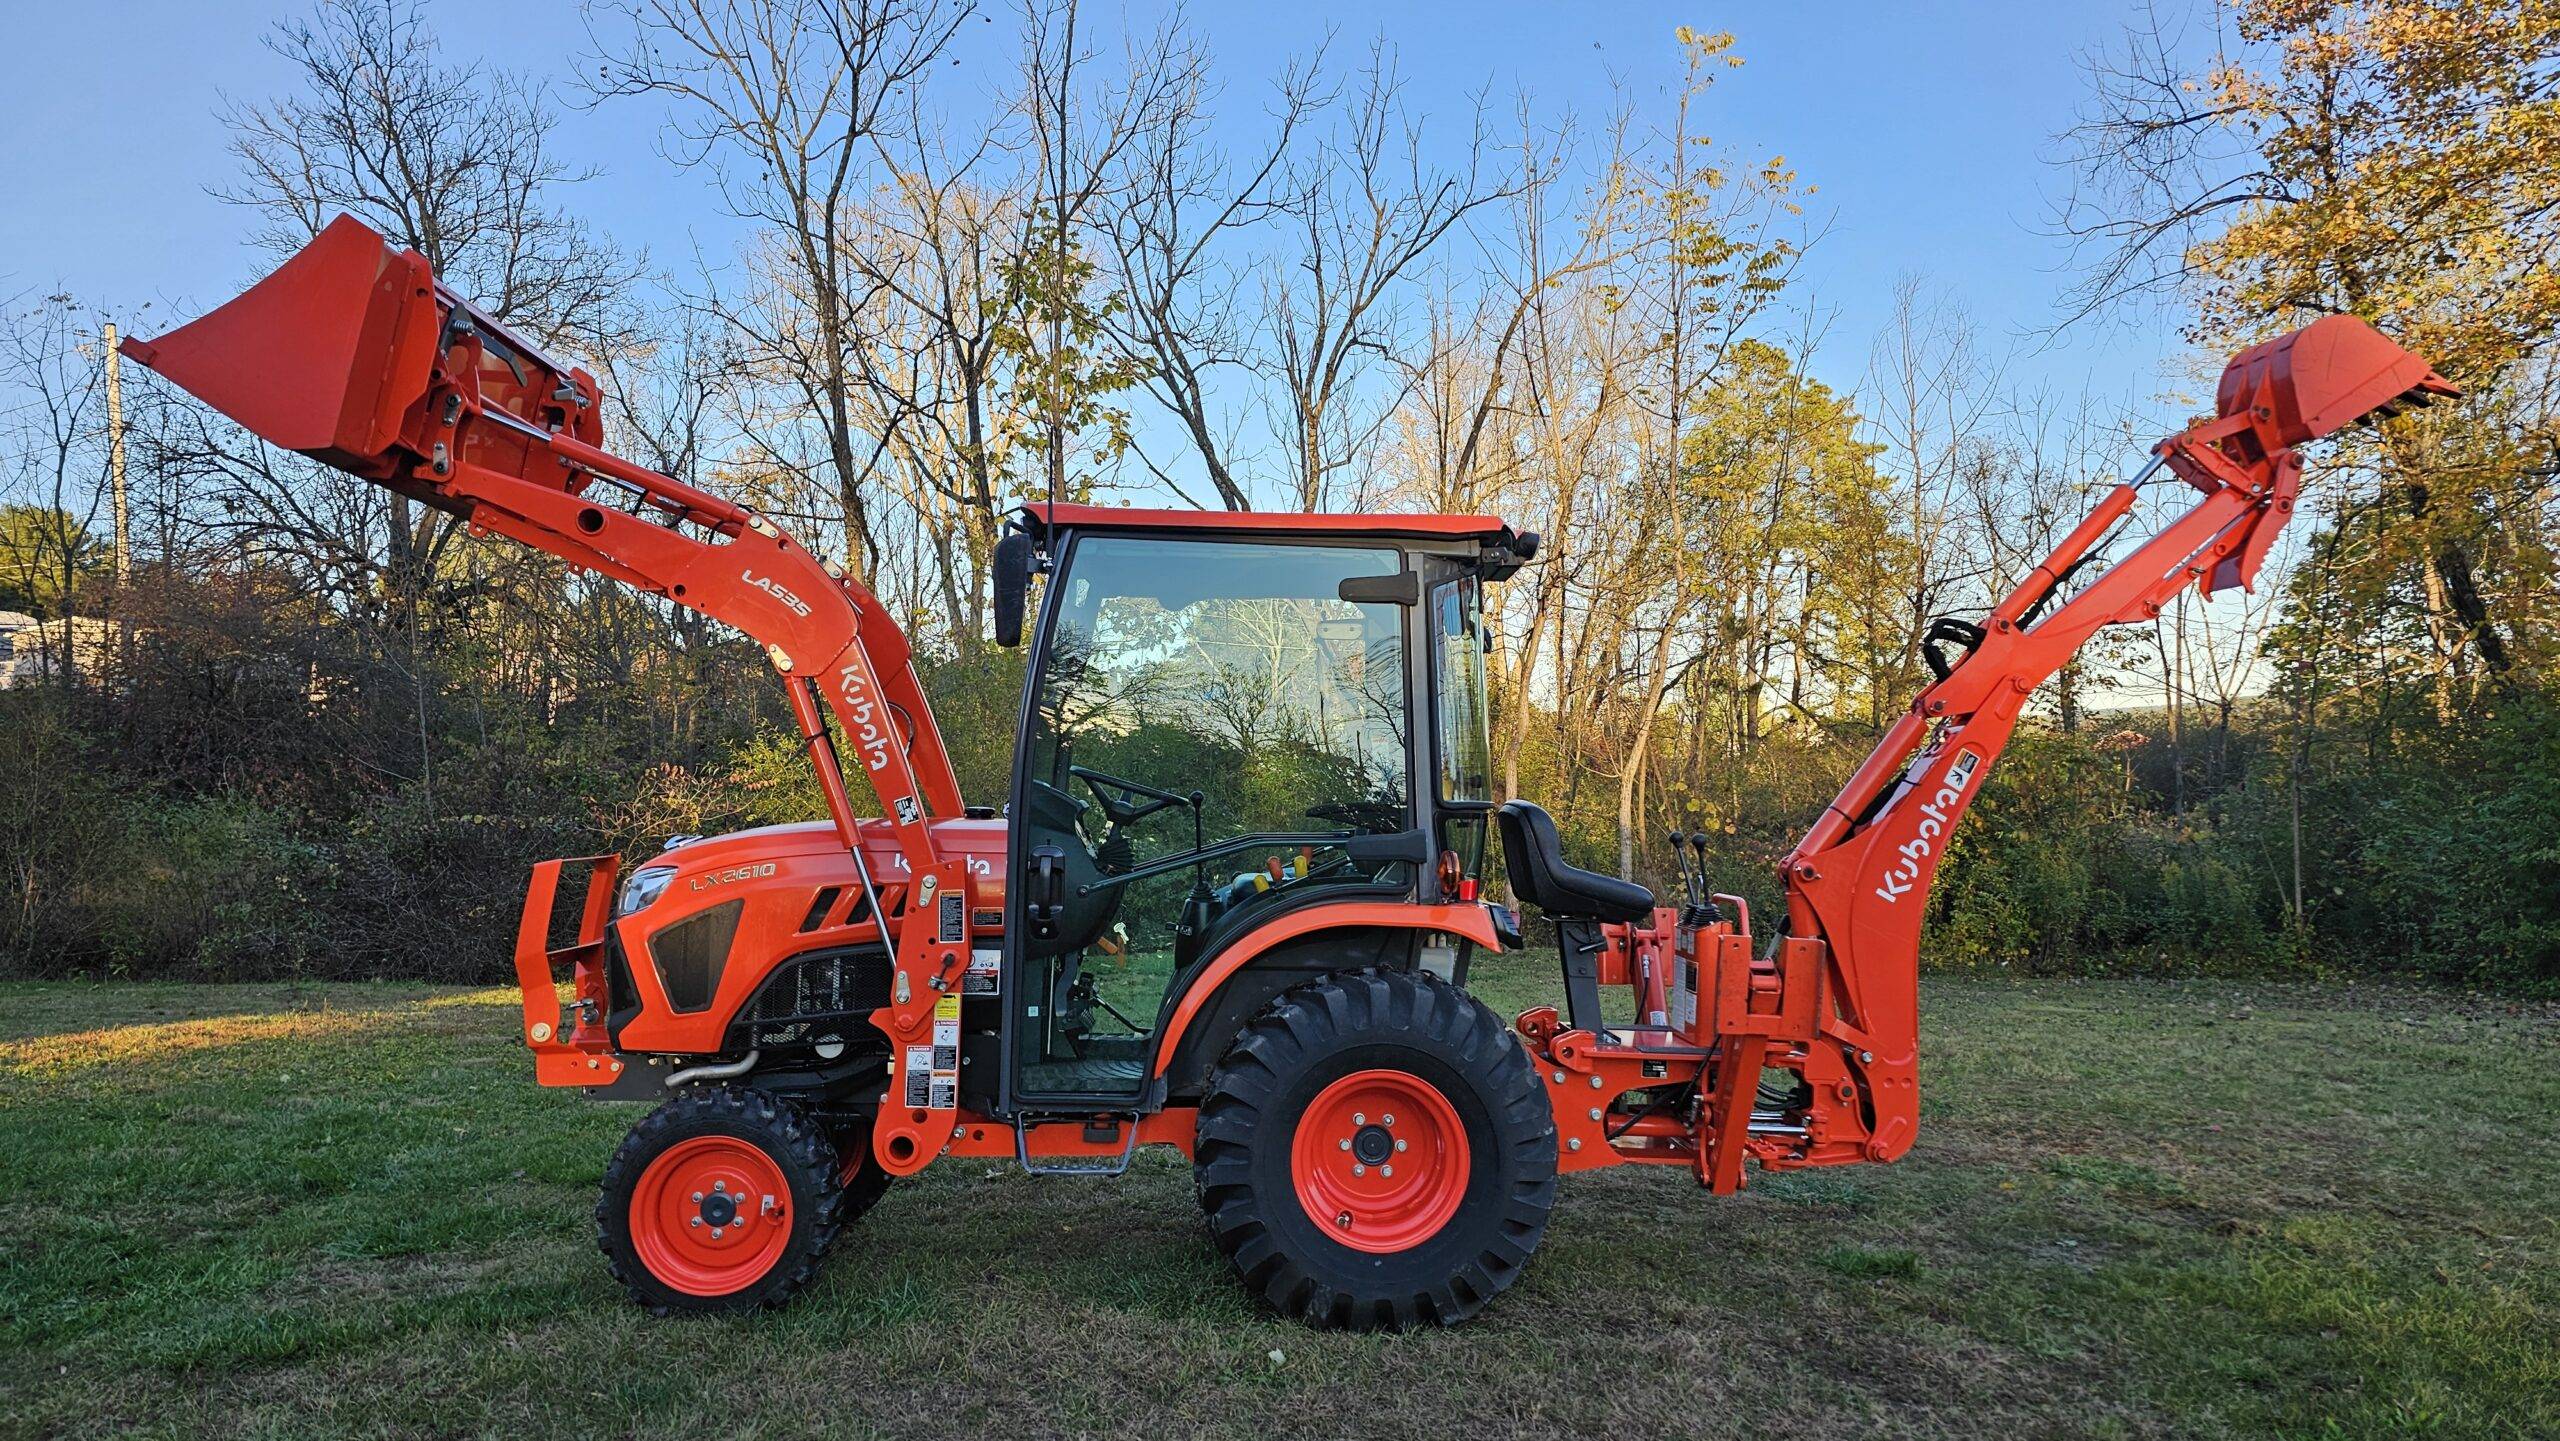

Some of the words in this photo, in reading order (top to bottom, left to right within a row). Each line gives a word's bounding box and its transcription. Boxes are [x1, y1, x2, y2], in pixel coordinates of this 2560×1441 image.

[741, 569, 813, 617] LA535
[840, 664, 888, 771] Kubota
[690, 863, 776, 891] LX2610
[1875, 788, 1961, 903] Kubota
